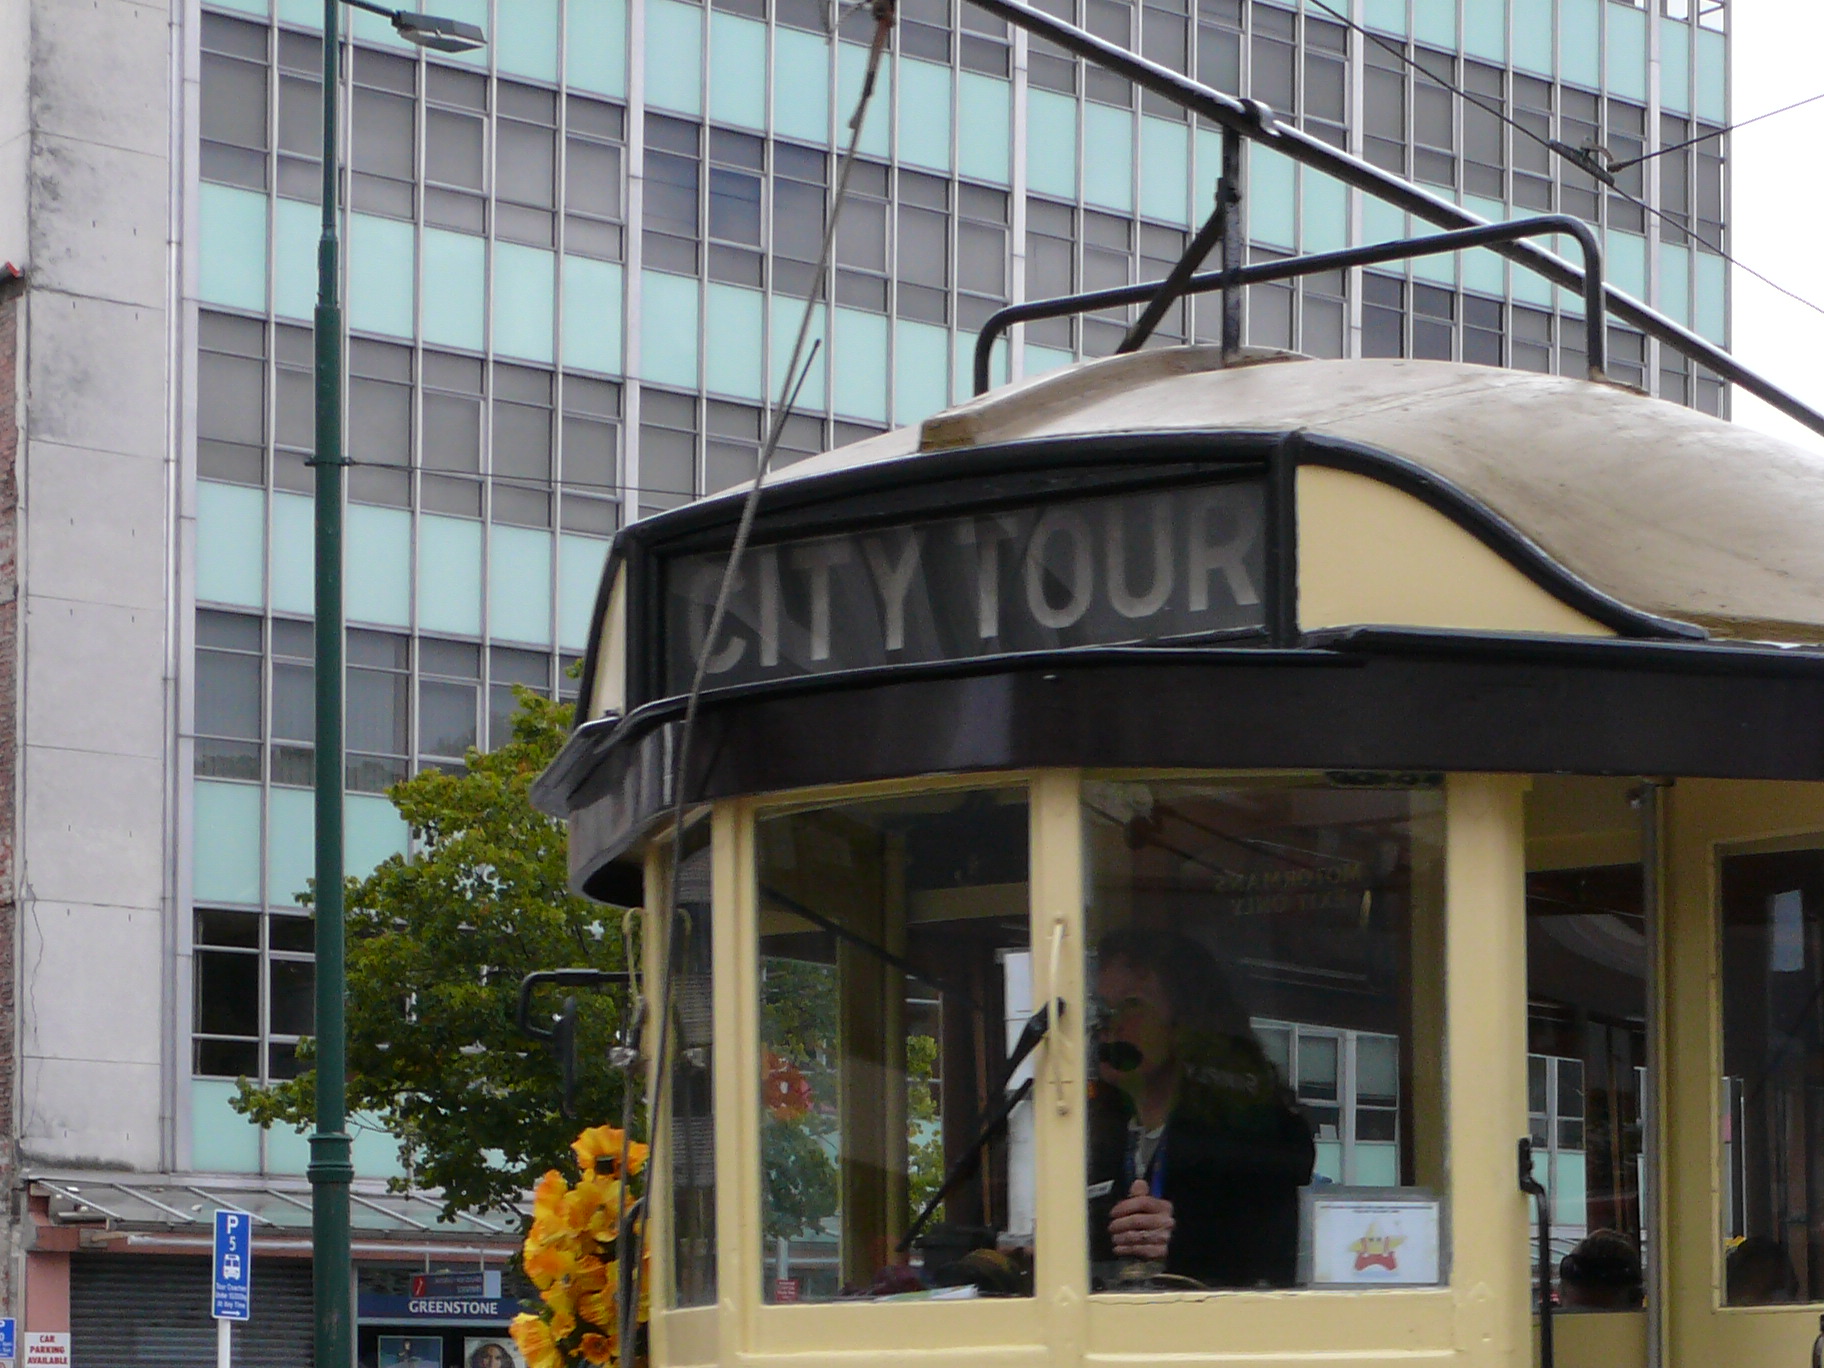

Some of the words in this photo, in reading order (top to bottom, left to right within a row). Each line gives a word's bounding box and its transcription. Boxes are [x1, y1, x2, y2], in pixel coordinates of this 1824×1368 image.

[688, 526, 927, 674] CITY
[957, 488, 1260, 639] TOUR
[226, 1214, 239, 1235] P
[229, 1235, 237, 1252] 5
[408, 1300, 499, 1315] GREENSTONE
[39, 1335, 56, 1343] CAR
[29, 1345, 65, 1354] PARKING
[27, 1356, 68, 1365] AVAILABLE
